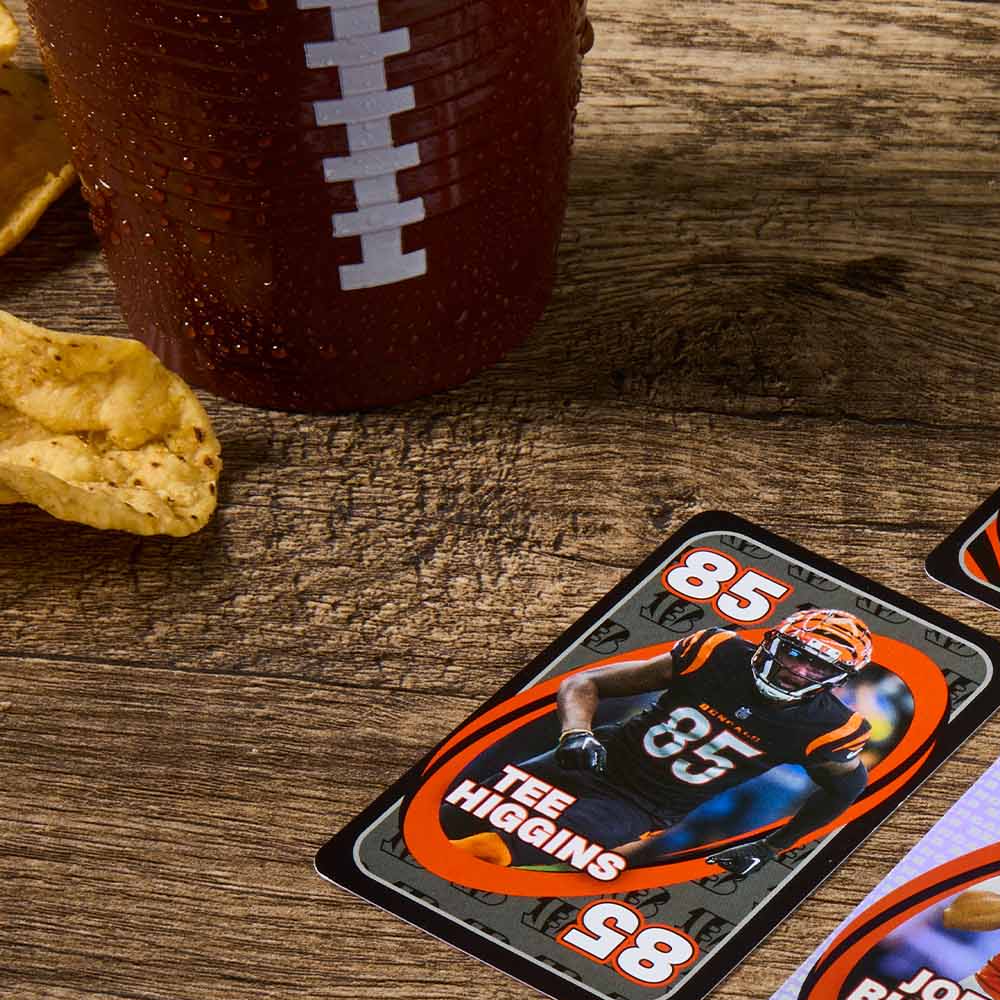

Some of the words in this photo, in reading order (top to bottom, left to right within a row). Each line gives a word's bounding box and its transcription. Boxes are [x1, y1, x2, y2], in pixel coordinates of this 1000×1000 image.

[661, 547, 795, 625] 85
[643, 706, 766, 785] 85
[443, 778, 628, 884] HIGGINS
[494, 765, 576, 822] TEE
[557, 901, 700, 987] 85
